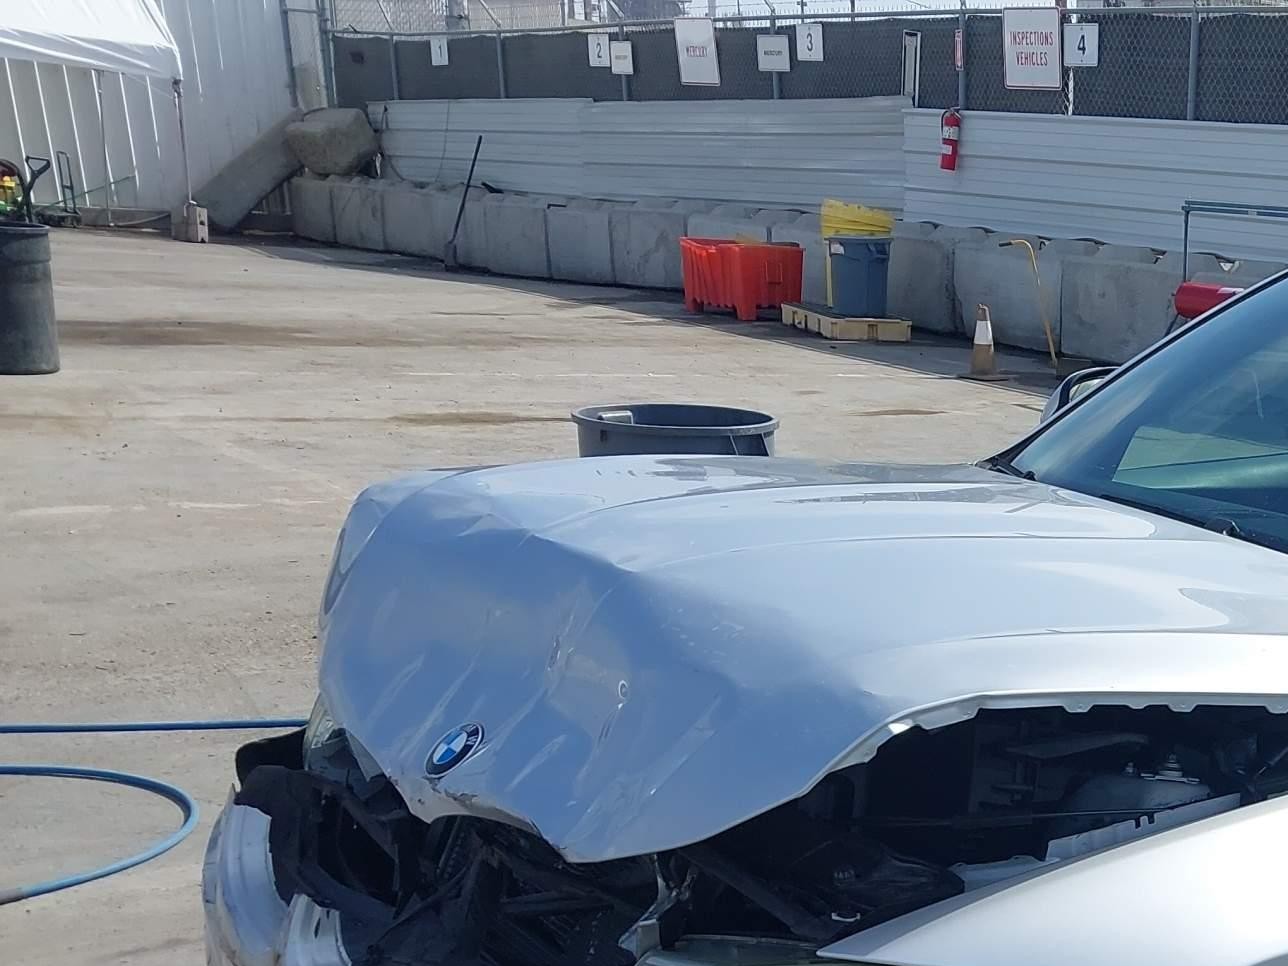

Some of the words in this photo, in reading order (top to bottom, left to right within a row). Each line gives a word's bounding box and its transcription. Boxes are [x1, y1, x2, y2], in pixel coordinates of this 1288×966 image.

[806, 32, 814, 52] 3
[1009, 31, 1054, 46] INSPECTIONS
[1076, 34, 1087, 56] 4
[595, 42, 603, 59] 2
[1016, 51, 1048, 66] VEHICLES
